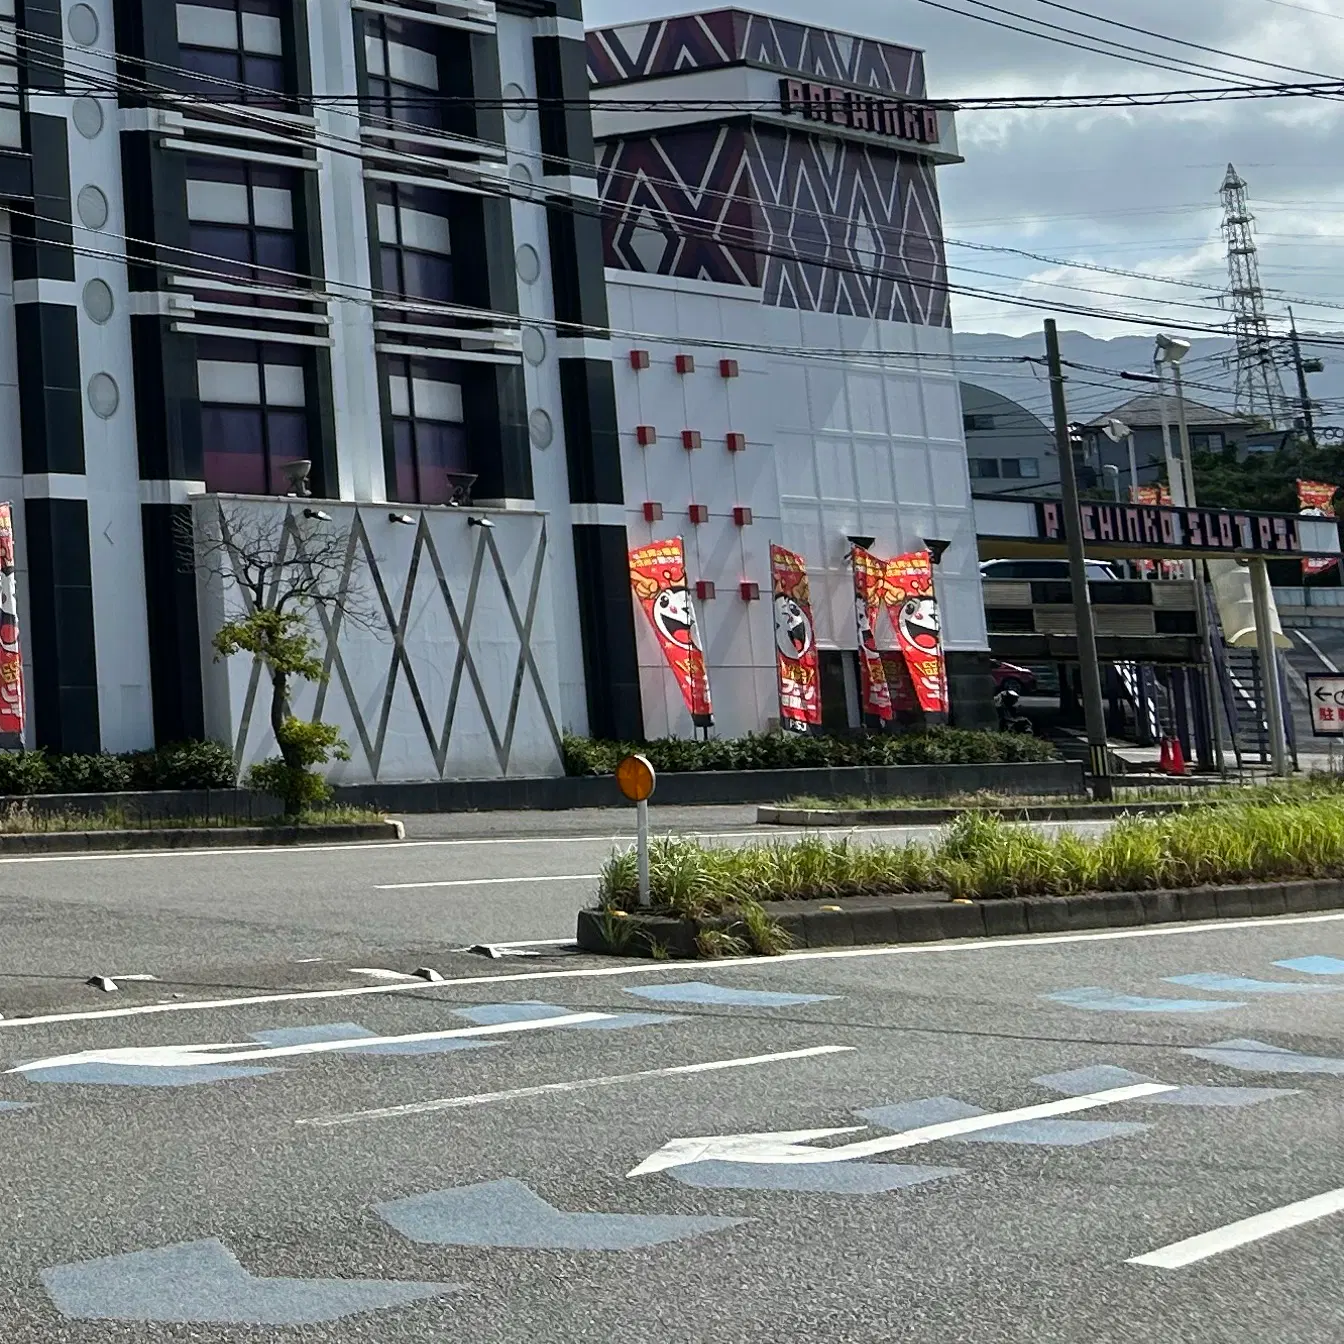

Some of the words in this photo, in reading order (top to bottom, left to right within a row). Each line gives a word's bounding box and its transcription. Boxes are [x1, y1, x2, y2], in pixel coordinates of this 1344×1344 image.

[1043, 502, 1174, 545] PCHINKO
[1187, 511, 1246, 548] SLOT
[1257, 515, 1299, 550] PSJ
[789, 719, 807, 732] PSJ
